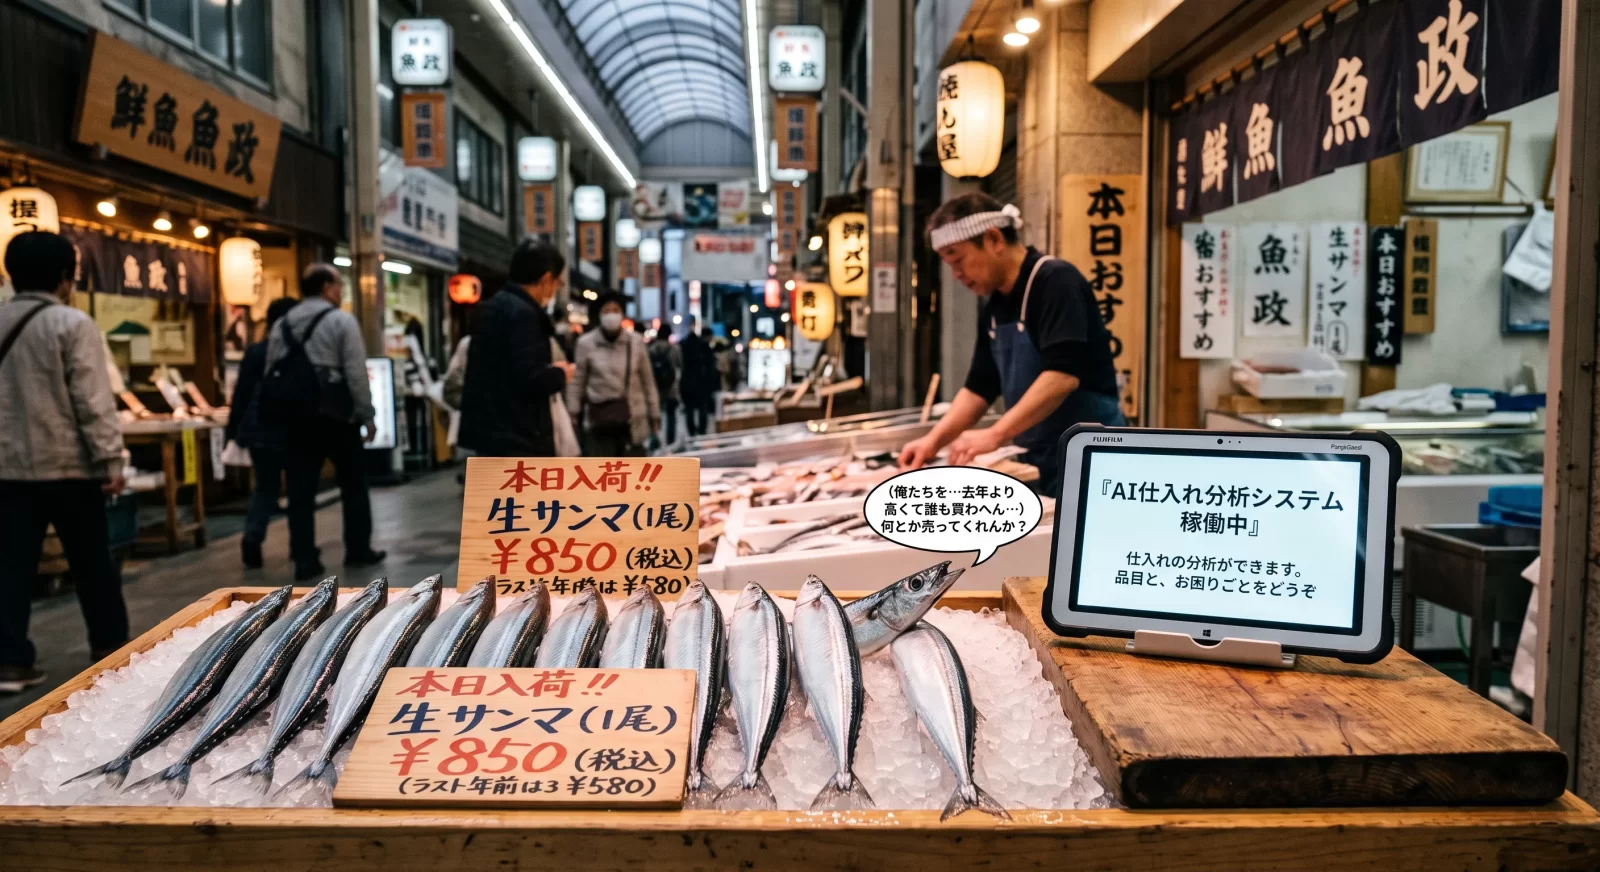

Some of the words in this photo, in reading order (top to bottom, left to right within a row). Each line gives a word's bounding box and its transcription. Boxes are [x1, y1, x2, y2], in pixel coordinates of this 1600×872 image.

[1201, 0, 1479, 193] 鮮魚魚政
[110, 73, 260, 185] 鮮魚魚政
[1252, 233, 1292, 328] 魚政
[1327, 226, 1350, 319] 生サンマ
[1374, 233, 1399, 359] 本日おすすめ
[1101, 478, 1344, 513] 『AI仕入れ分析システム
[1179, 510, 1260, 538] 稼働中』
[490, 537, 617, 575] ¥850
[625, 546, 694, 572] (税込)
[1126, 551, 1303, 579] 仕入れの分析ができます。
[1114, 569, 1318, 600] 品目と、お困りごとをどうぞ
[387, 701, 678, 736] 生サンマ(1尾)
[389, 736, 569, 777] ¥850
[574, 747, 677, 774] (税込)
[566, 775, 657, 797] ¥580)
